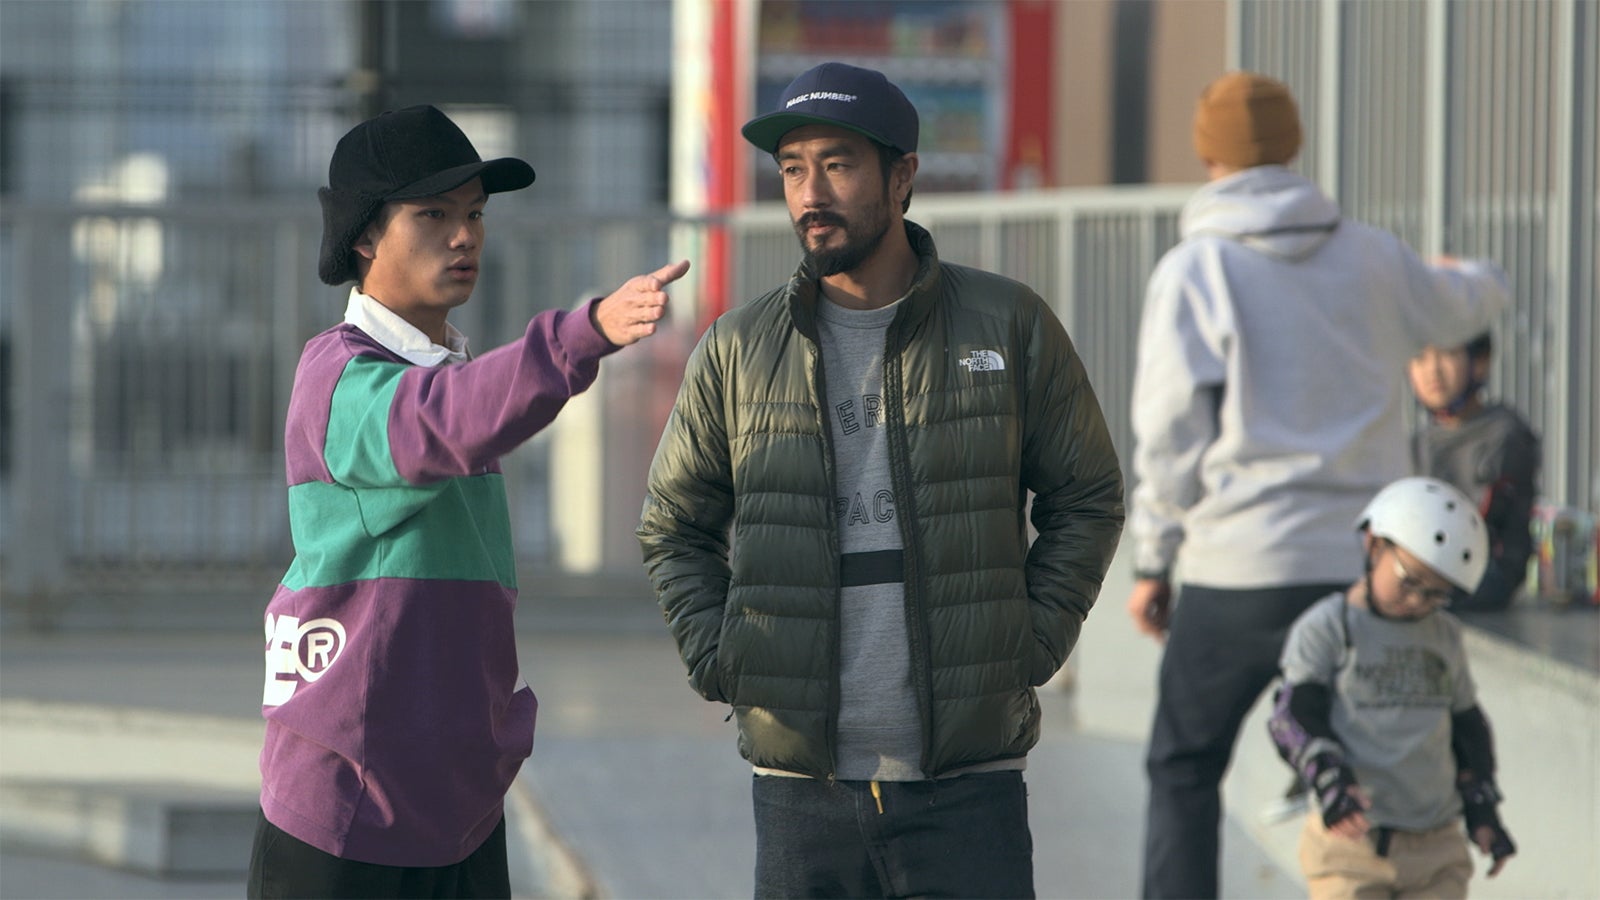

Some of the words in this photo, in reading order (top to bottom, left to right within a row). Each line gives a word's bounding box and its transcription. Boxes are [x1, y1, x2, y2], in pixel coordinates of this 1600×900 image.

[786, 94, 809, 108] MAGIC
[970, 350, 988, 358] THE
[959, 357, 989, 366] NORTH
[968, 364, 990, 372] FACE
